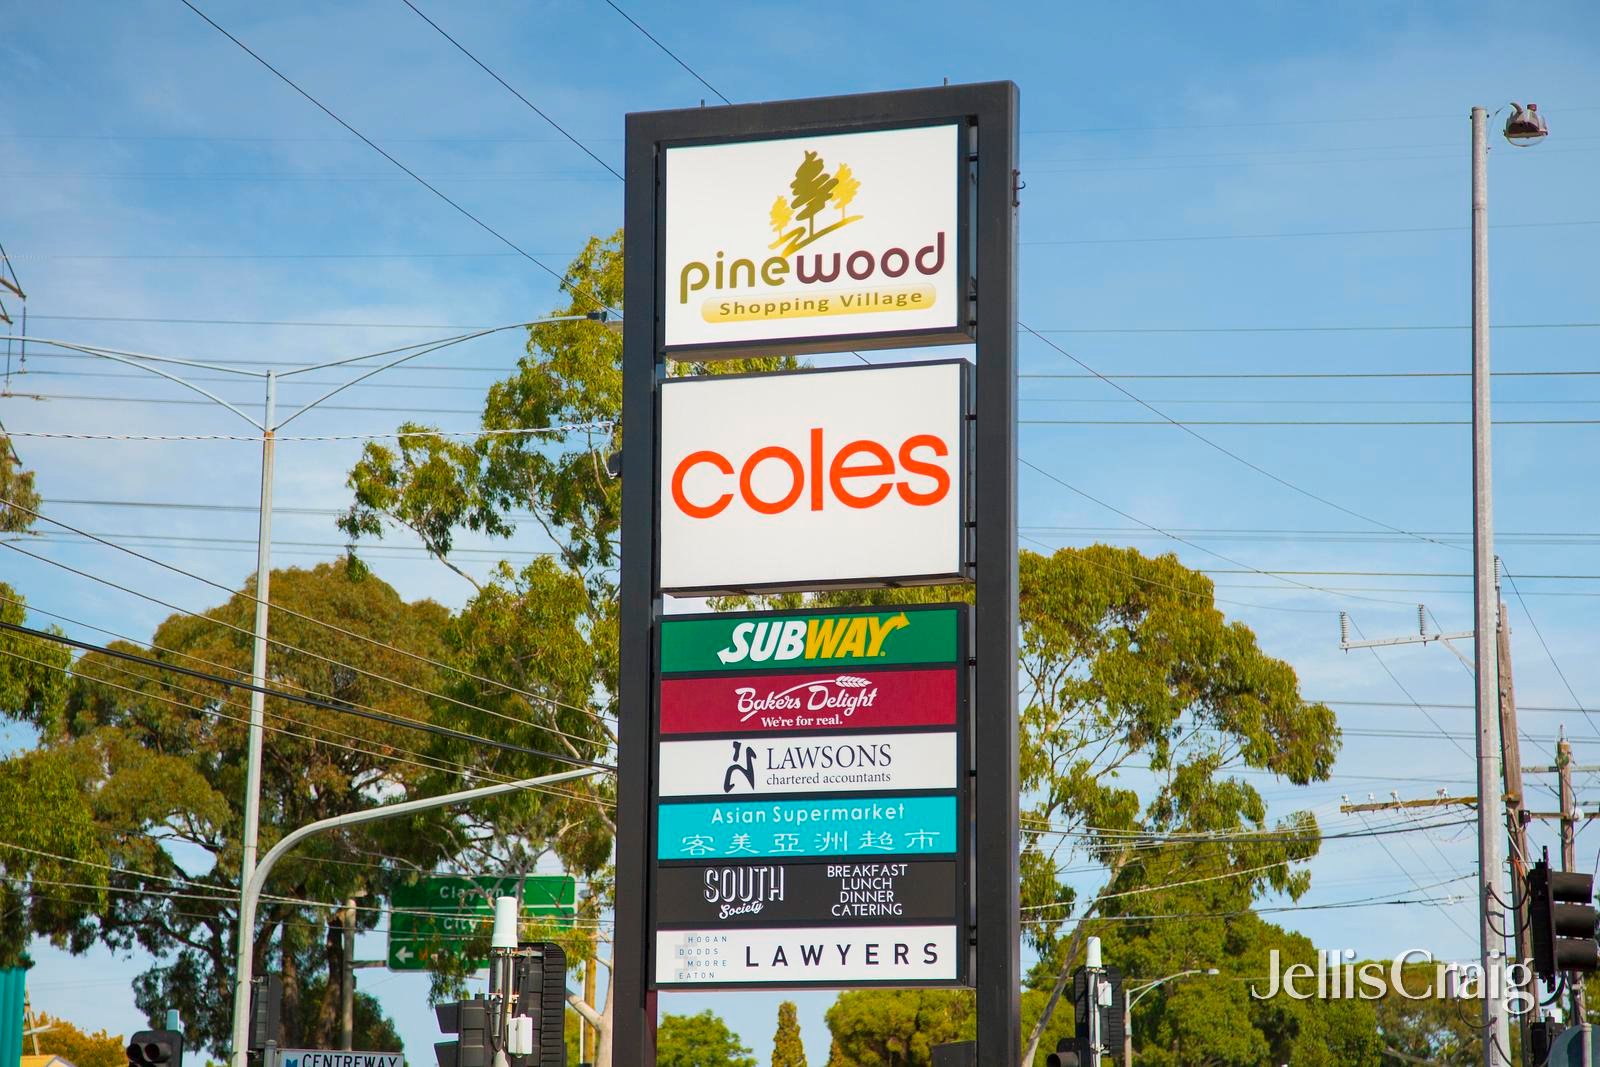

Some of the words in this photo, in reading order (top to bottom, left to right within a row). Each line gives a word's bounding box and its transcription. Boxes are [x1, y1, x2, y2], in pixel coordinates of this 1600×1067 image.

[680, 232, 945, 304] pinewood
[719, 297, 831, 316] Shopping
[840, 291, 923, 308] Village
[671, 428, 950, 519] coles
[716, 612, 911, 665] SUBWAY
[735, 687, 801, 717] Bakers
[807, 685, 878, 716] Delight
[761, 717, 794, 728] We're
[796, 715, 814, 726] for
[816, 714, 843, 726] real.
[766, 743, 892, 770] LAWSONS
[766, 772, 820, 786] chartered
[823, 772, 891, 784] accountants
[711, 806, 767, 825] Asian
[772, 804, 906, 824] Supermarket
[679, 828, 941, 857] 客美亞洲超市
[826, 864, 908, 878] BREAKFAST
[703, 865, 785, 904] SOUTH
[841, 877, 893, 891] LUNCH
[839, 890, 895, 904] DINNER
[719, 901, 763, 919] Society
[830, 903, 904, 917] CATERING
[679, 948, 719, 956] DODDS
[745, 942, 939, 968] LAWYERS
[687, 960, 728, 968] MOORE
[678, 972, 716, 980] EATON
